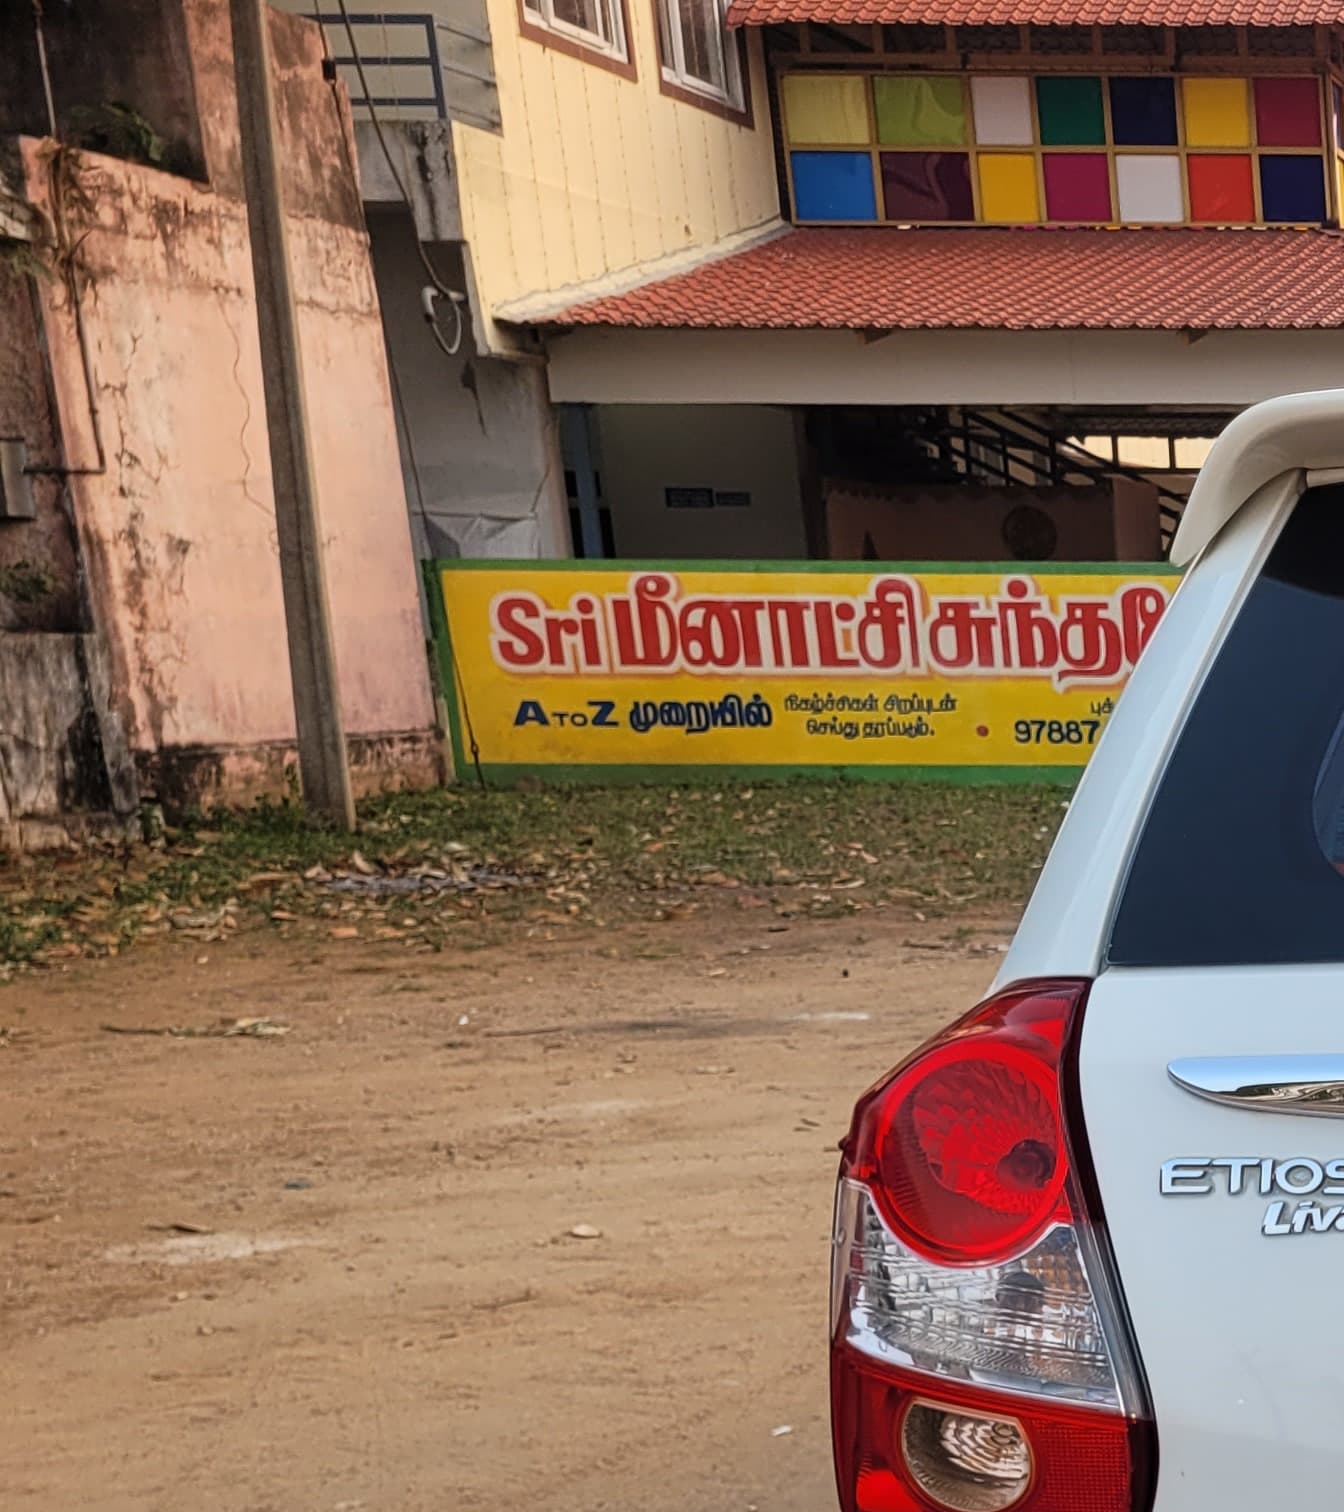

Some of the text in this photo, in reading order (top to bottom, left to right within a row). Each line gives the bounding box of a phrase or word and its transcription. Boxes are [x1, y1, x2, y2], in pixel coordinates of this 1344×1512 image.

[496, 597, 602, 666] Sri
[611, 574, 919, 668] மீனாட்சி
[629, 693, 772, 735] முறையில்
[1014, 719, 1100, 745] 97887
